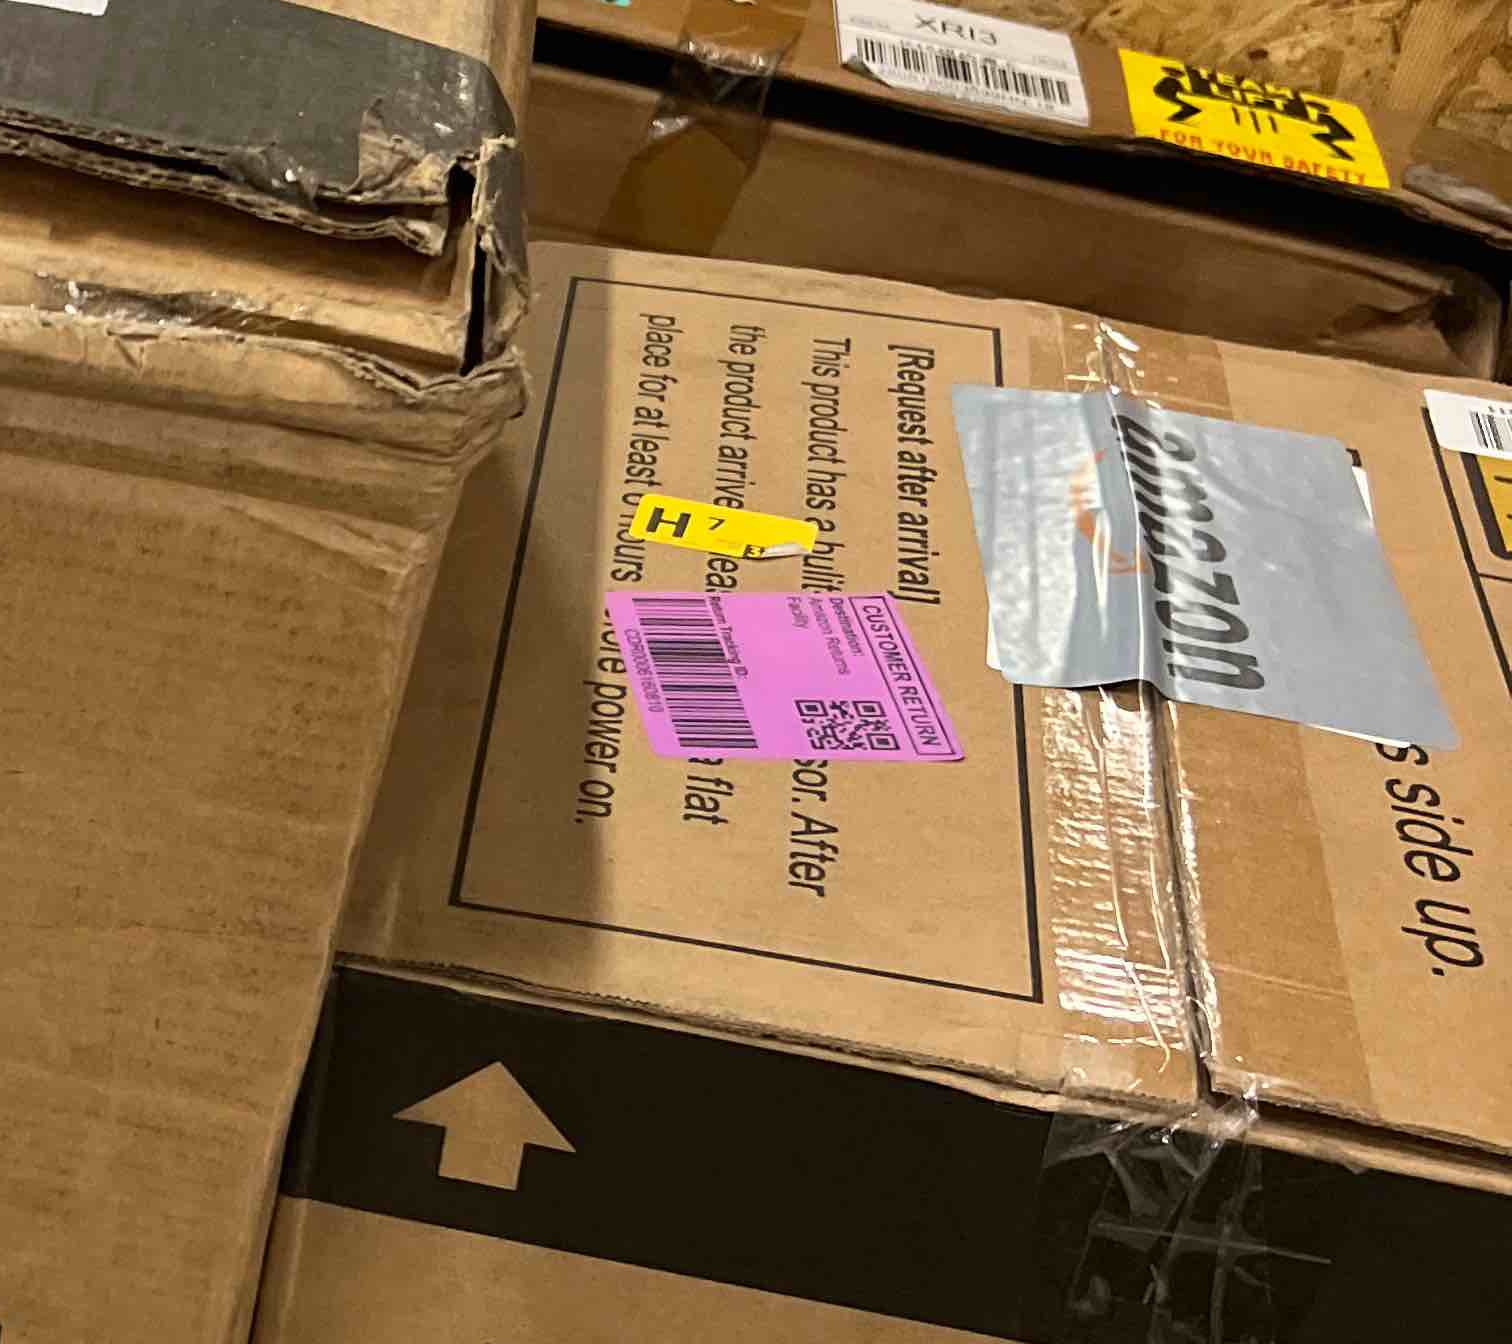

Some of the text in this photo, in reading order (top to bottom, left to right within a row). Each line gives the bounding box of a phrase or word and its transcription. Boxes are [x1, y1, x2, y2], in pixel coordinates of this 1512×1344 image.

[640, 313, 684, 369] place
[810, 336, 853, 379] This
[632, 407, 670, 429] at
[638, 372, 678, 403] for
[802, 381, 851, 460] product
[624, 432, 670, 488] least
[806, 464, 852, 512] has
[897, 442, 940, 510] after
[645, 507, 693, 538] H
[1110, 414, 1267, 692] amazon
[682, 324, 766, 826] the product flat
[863, 603, 942, 748] CUSTOMER RETURN
[583, 679, 628, 774] power
[573, 779, 615, 825] on.
[1386, 778, 1476, 884] side
[788, 813, 840, 898] After
[1400, 898, 1486, 977] up.
